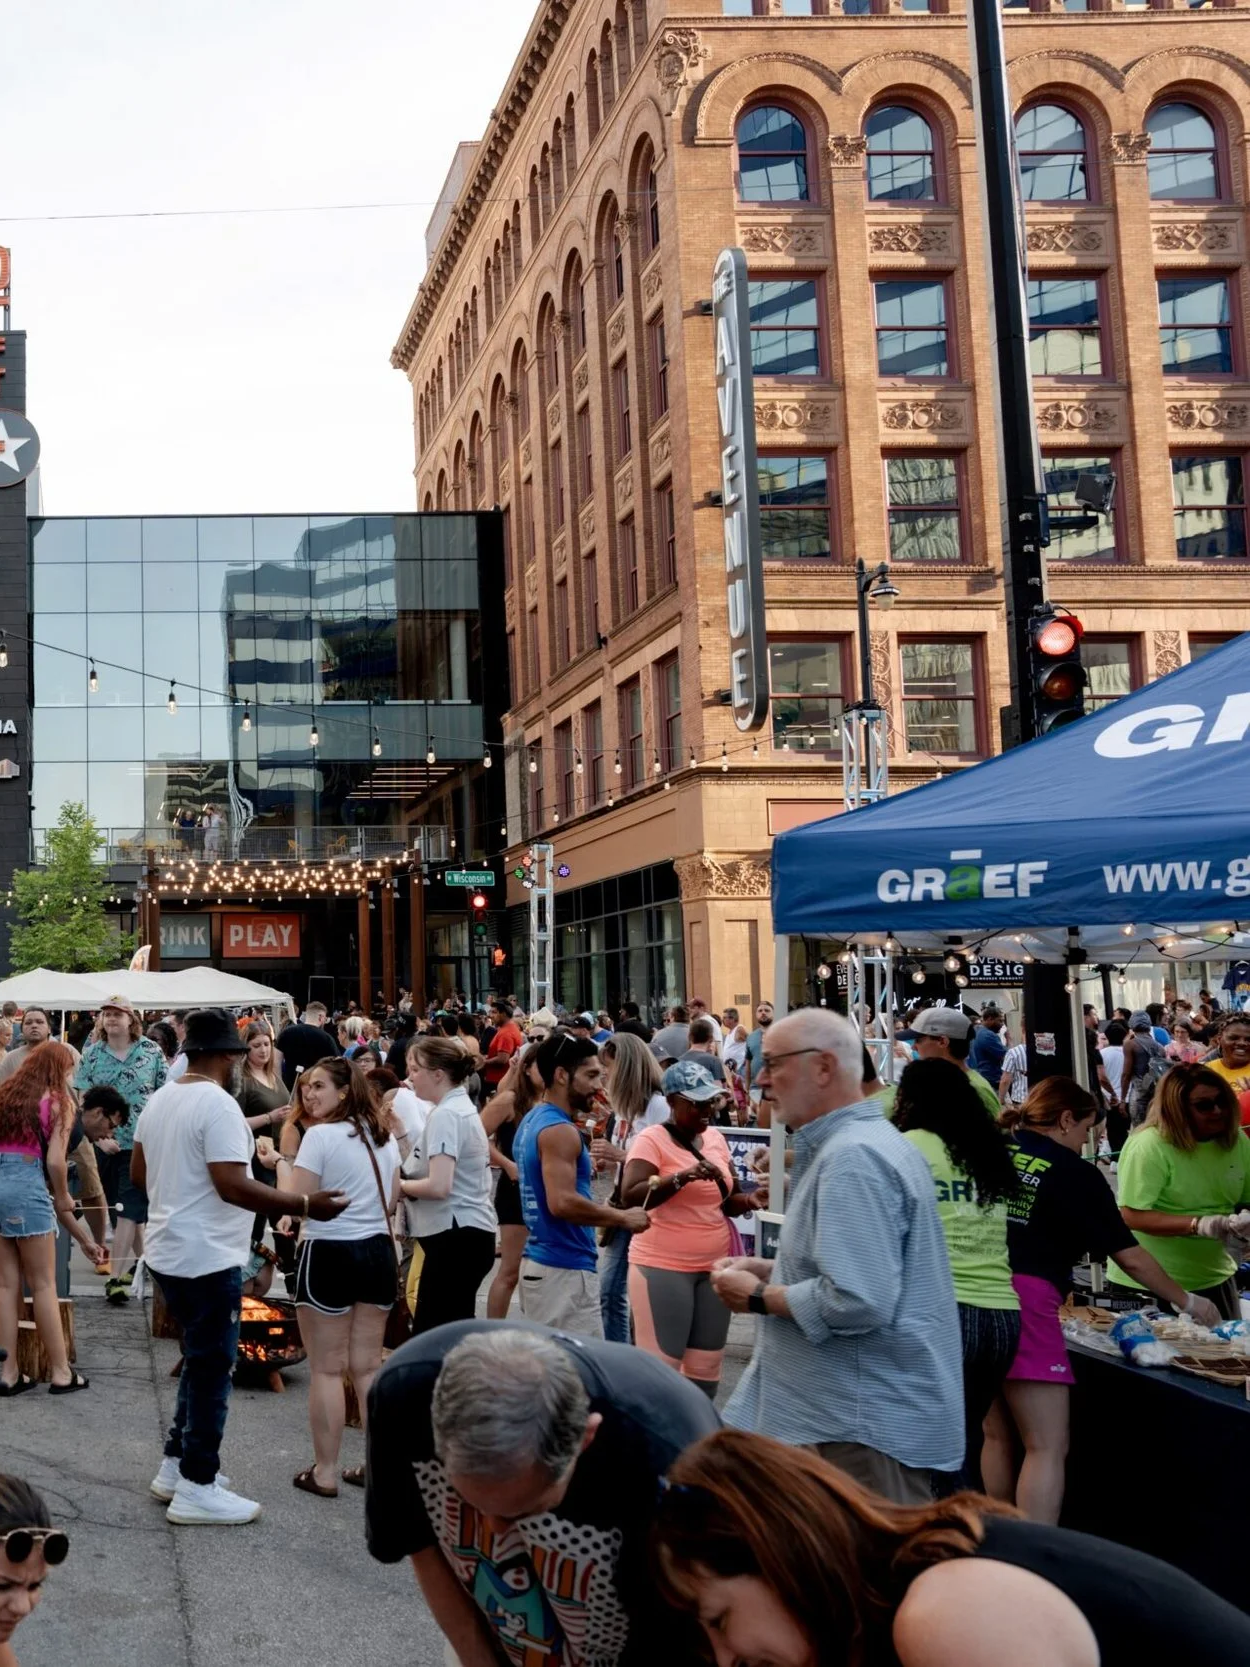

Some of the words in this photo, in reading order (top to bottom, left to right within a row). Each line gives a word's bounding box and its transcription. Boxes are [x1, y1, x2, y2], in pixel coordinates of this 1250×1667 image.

[712, 269, 734, 304] THE
[715, 316, 750, 709] AVENUE
[453, 873, 487, 884] Wisconsin
[159, 926, 206, 946] RINK
[229, 924, 293, 948] PLAY
[969, 964, 1024, 977] DESIG
